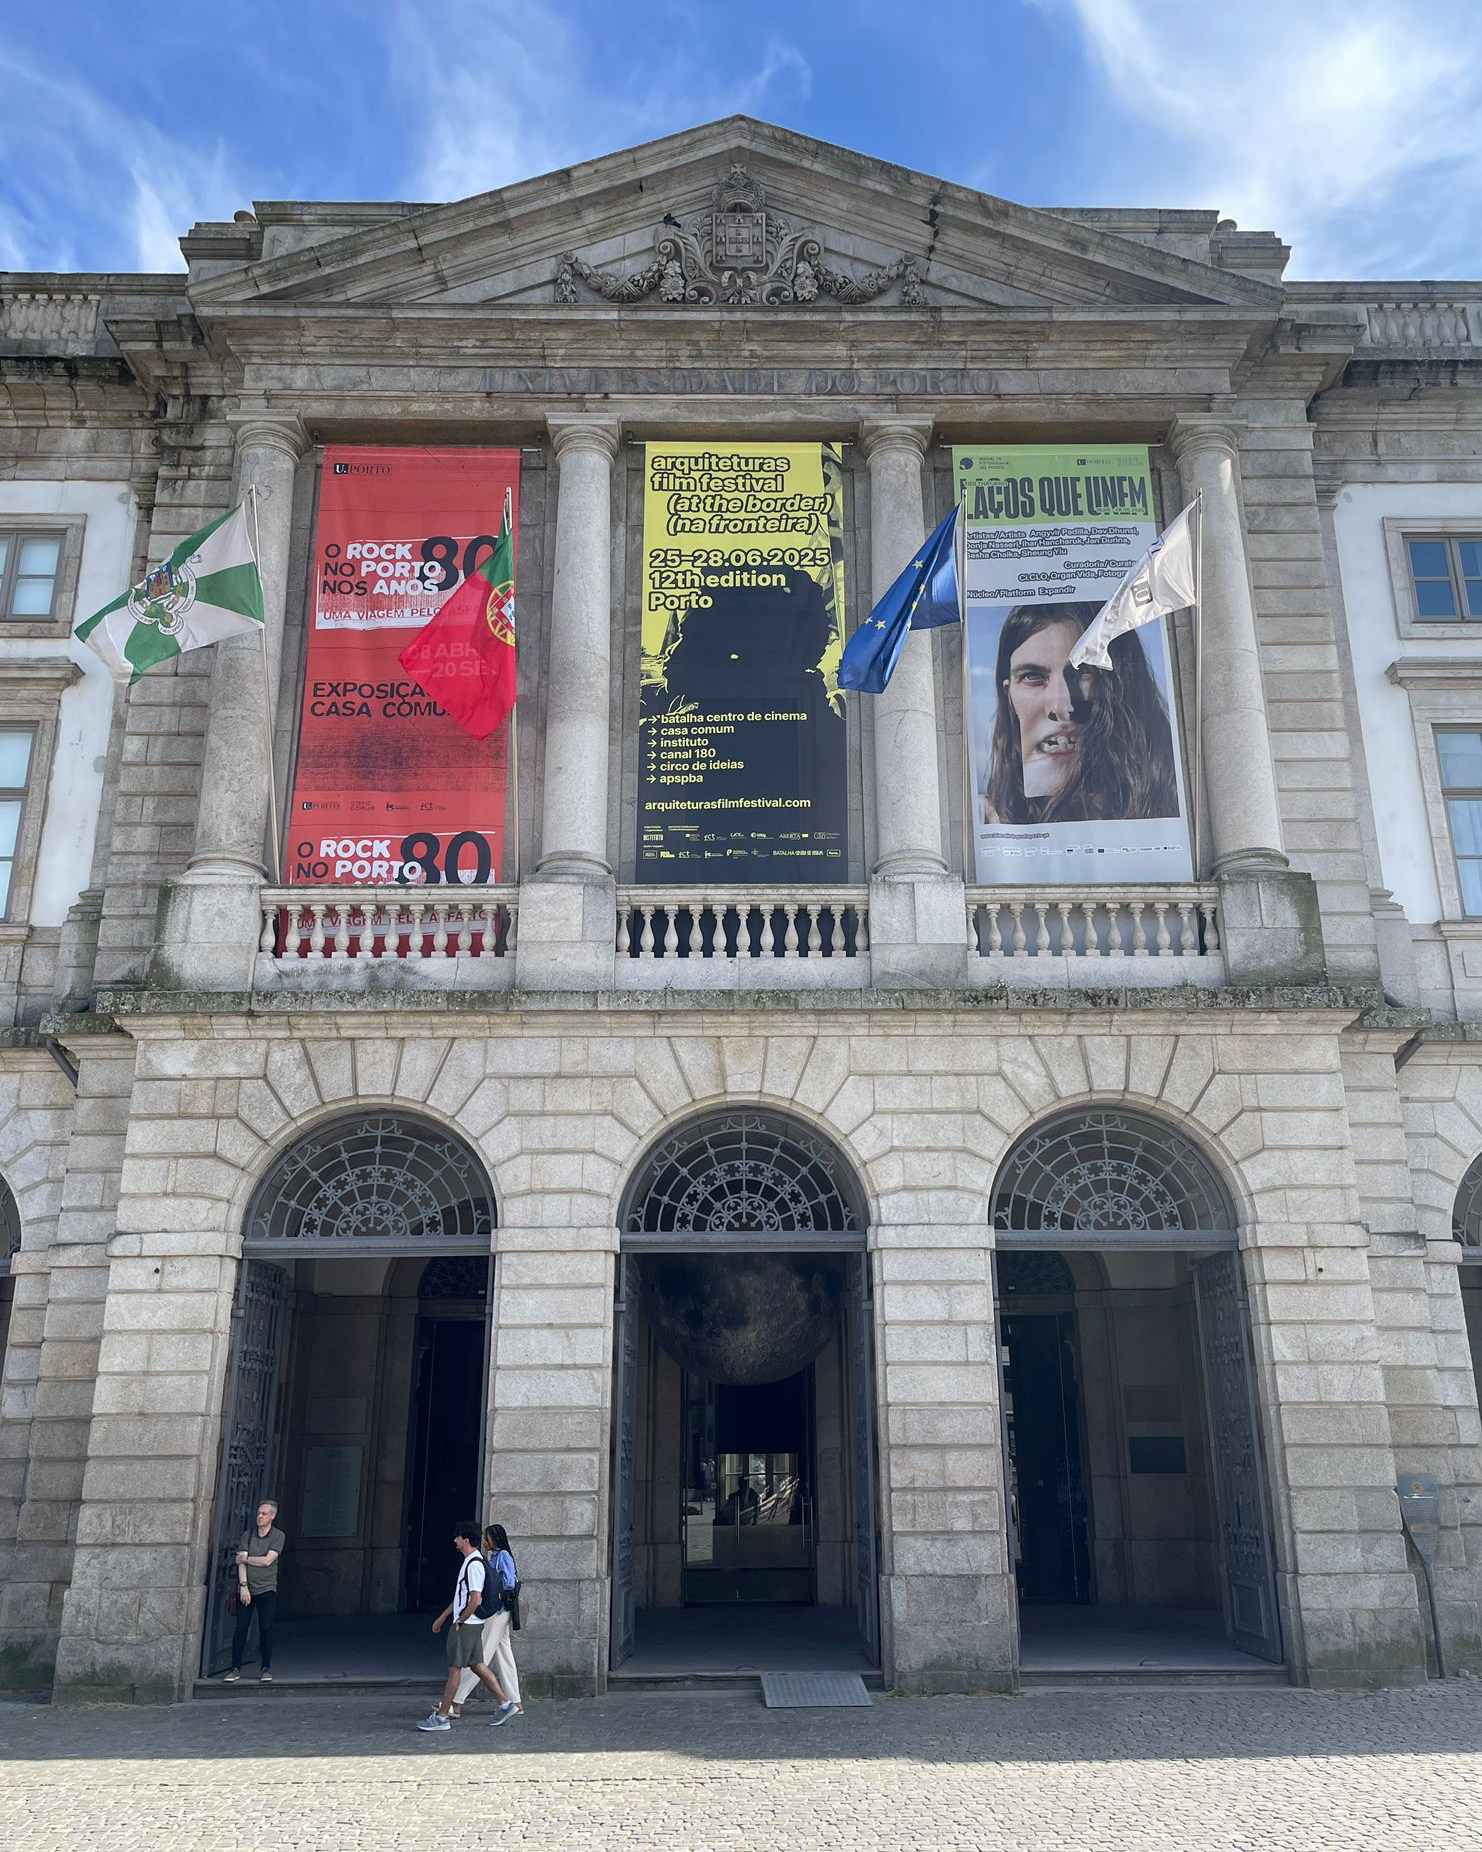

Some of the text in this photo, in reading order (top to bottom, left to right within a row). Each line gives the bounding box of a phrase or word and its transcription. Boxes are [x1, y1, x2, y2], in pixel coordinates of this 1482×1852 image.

[810, 370, 861, 393] DO
[875, 370, 998, 393] PORTO
[651, 452, 790, 475] arquiteturas
[651, 473, 784, 493] film festival
[667, 494, 833, 514] (at the border)
[1039, 476, 1084, 517] QUE
[1085, 476, 1149, 516] UNEM
[666, 514, 819, 536] (na fronteira)
[1000, 531, 1026, 539] Artists
[1091, 527, 1108, 535] Dev
[1085, 537, 1100, 545] Jan
[1101, 536, 1131, 545] Durina,
[324, 543, 412, 560] O ROCK
[1020, 548, 1054, 558] Sheung
[1053, 547, 1067, 555] Yiu
[324, 560, 441, 578] NO PORTO
[1064, 560, 1108, 569] Curadoria/
[650, 570, 787, 589] 12th edition
[1050, 571, 1077, 580] Organ
[1076, 570, 1098, 579] Vida,
[322, 579, 439, 596] NOS ANOS
[967, 585, 1076, 598] Núcleo/ Platform Expandir
[649, 592, 713, 611] Porto
[323, 611, 351, 620] UMA
[357, 608, 404, 620] VIAGEM
[311, 701, 450, 718] CASA COMU
[661, 711, 808, 724] batalha centro de cinema
[661, 726, 734, 736] casa comum
[660, 738, 709, 748] instituto
[660, 748, 716, 760] canal 180
[660, 759, 745, 772] circo de ideias
[659, 774, 704, 785] apspba
[644, 798, 811, 812] arquiteturasfilmfestival.com
[297, 839, 391, 858] O ROCK
[399, 831, 492, 884] 80
[297, 861, 422, 880] NO PORTO
